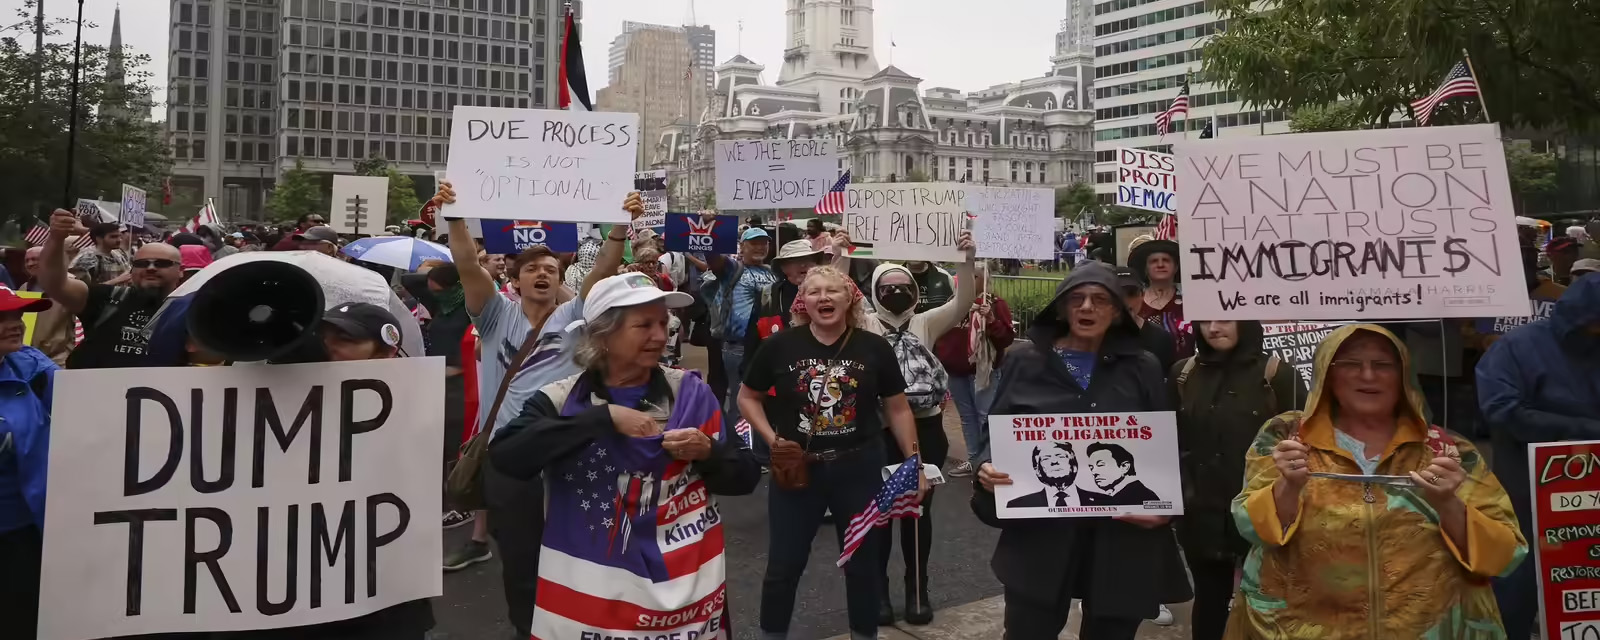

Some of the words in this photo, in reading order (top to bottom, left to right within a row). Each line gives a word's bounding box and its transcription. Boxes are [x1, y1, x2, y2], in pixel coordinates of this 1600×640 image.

[468, 120, 529, 141] DUE
[543, 120, 631, 147] PROCESS
[720, 141, 745, 161] WE
[750, 141, 781, 160] THE
[787, 140, 828, 158] PEOPLE
[1121, 149, 1174, 172] DISS
[506, 155, 530, 168] IS
[543, 155, 585, 169] NOT
[1189, 153, 1261, 181] WE
[1278, 146, 1408, 175] MUST
[1426, 142, 1487, 171] BE
[1120, 167, 1176, 191] PROT
[848, 188, 906, 209] DEPORT
[910, 188, 965, 206] TRUMP
[1119, 185, 1176, 211] DEMOC
[1191, 182, 1230, 216] A
[1249, 170, 1491, 214] NATION
[847, 213, 880, 241] FREE
[890, 211, 966, 247] PALESTINE
[1192, 214, 1303, 241] THAT
[1313, 206, 1497, 238] TRUSTS
[513, 228, 546, 243] NO
[689, 235, 713, 246] NO
[1190, 238, 1471, 281] IMMIGRANTS
[1218, 290, 1247, 311] We
[1254, 294, 1281, 306] are
[1289, 290, 1309, 305] all
[1320, 284, 1423, 312] immigrants!
[1427, 285, 1496, 296] HARRIS
[1276, 323, 1318, 333] TRUMP
[1495, 316, 1548, 326] FRIEN
[114, 344, 143, 354] LET'S
[788, 359, 824, 372] LATINA
[828, 359, 865, 371] POWER
[1012, 417, 1056, 429] STOP
[1061, 416, 1120, 428] TRUMP
[1126, 415, 1138, 426] &
[123, 379, 394, 497] DUMP
[1013, 430, 1046, 441] THE
[1052, 426, 1153, 440] OLIGARCH$
[1560, 495, 1582, 508] DO
[1588, 492, 1600, 506] Y
[93, 492, 411, 617] TRUMP
[636, 606, 700, 627] SHOW
